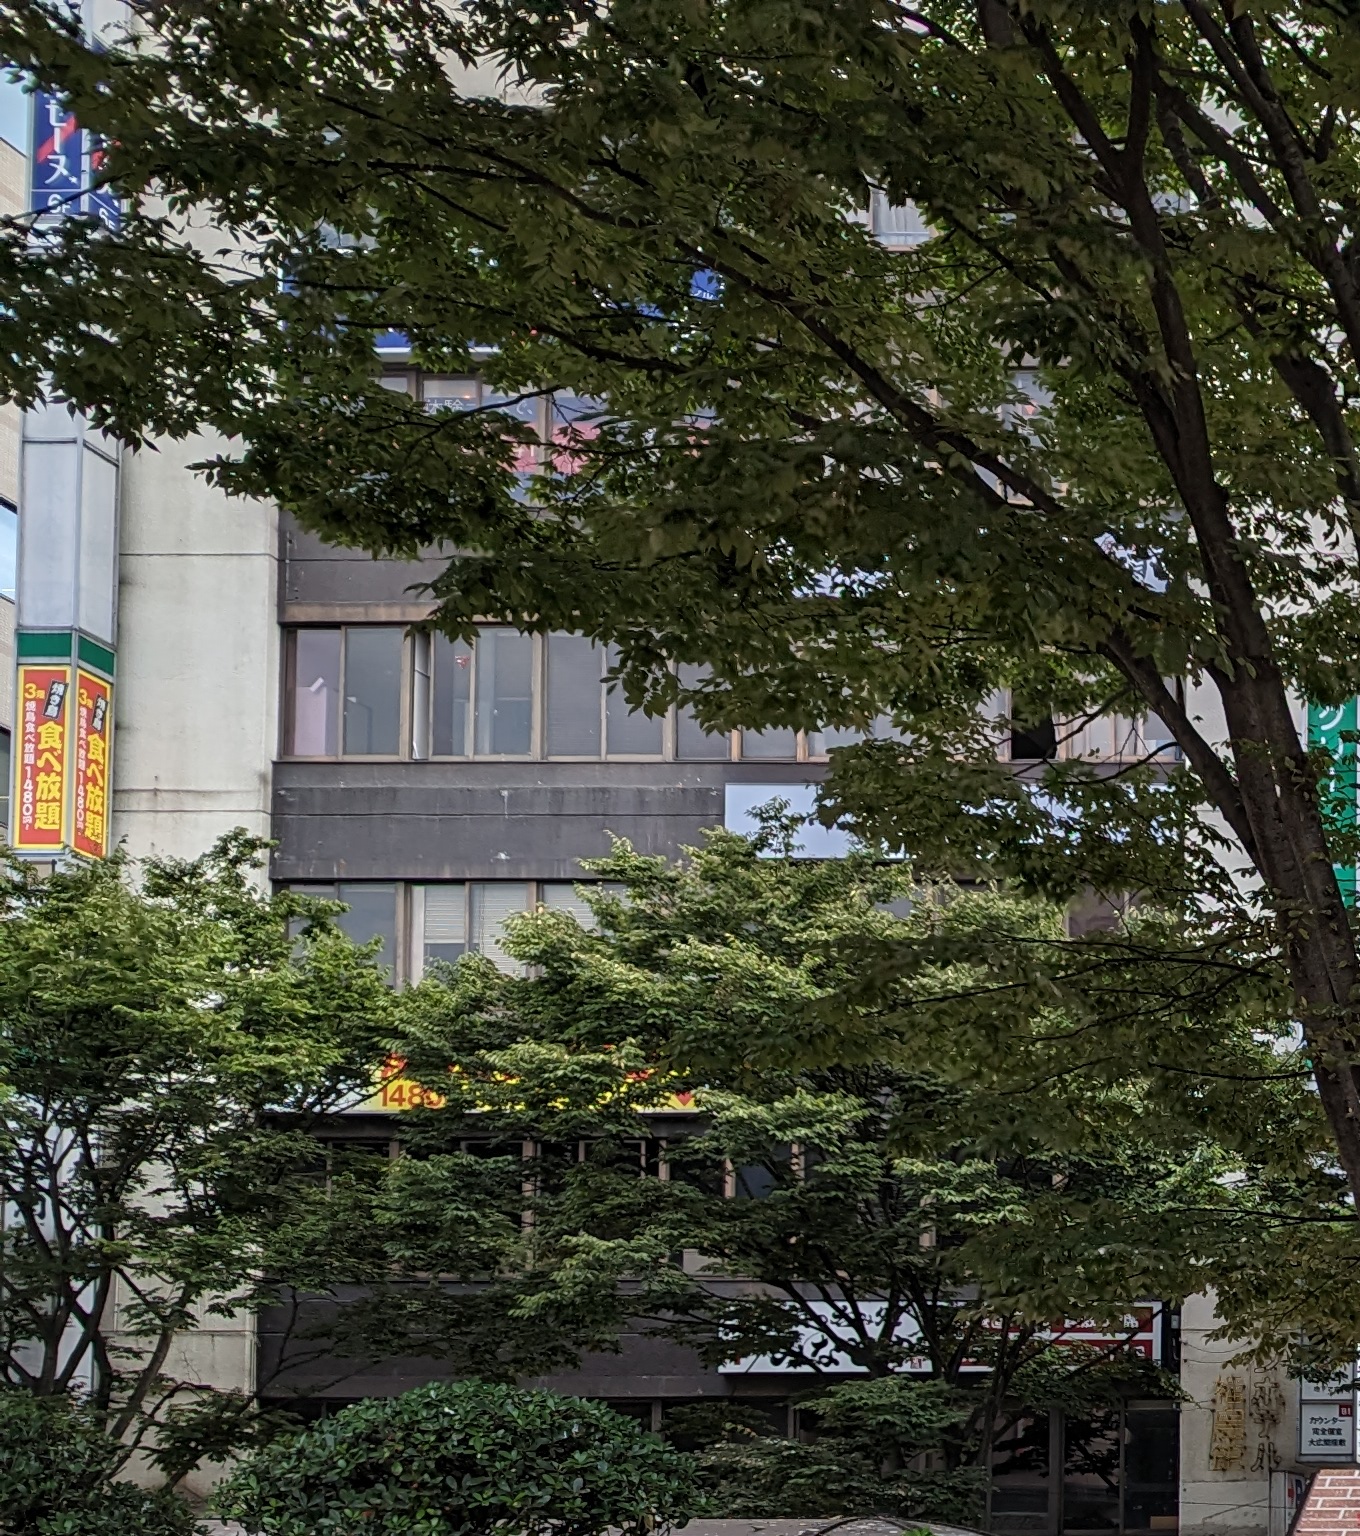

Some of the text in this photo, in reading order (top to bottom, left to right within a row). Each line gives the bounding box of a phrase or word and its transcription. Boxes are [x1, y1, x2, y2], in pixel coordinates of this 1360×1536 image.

[36, 722, 63, 829] 食べ放題
[86, 734, 105, 842] 食べ放題
